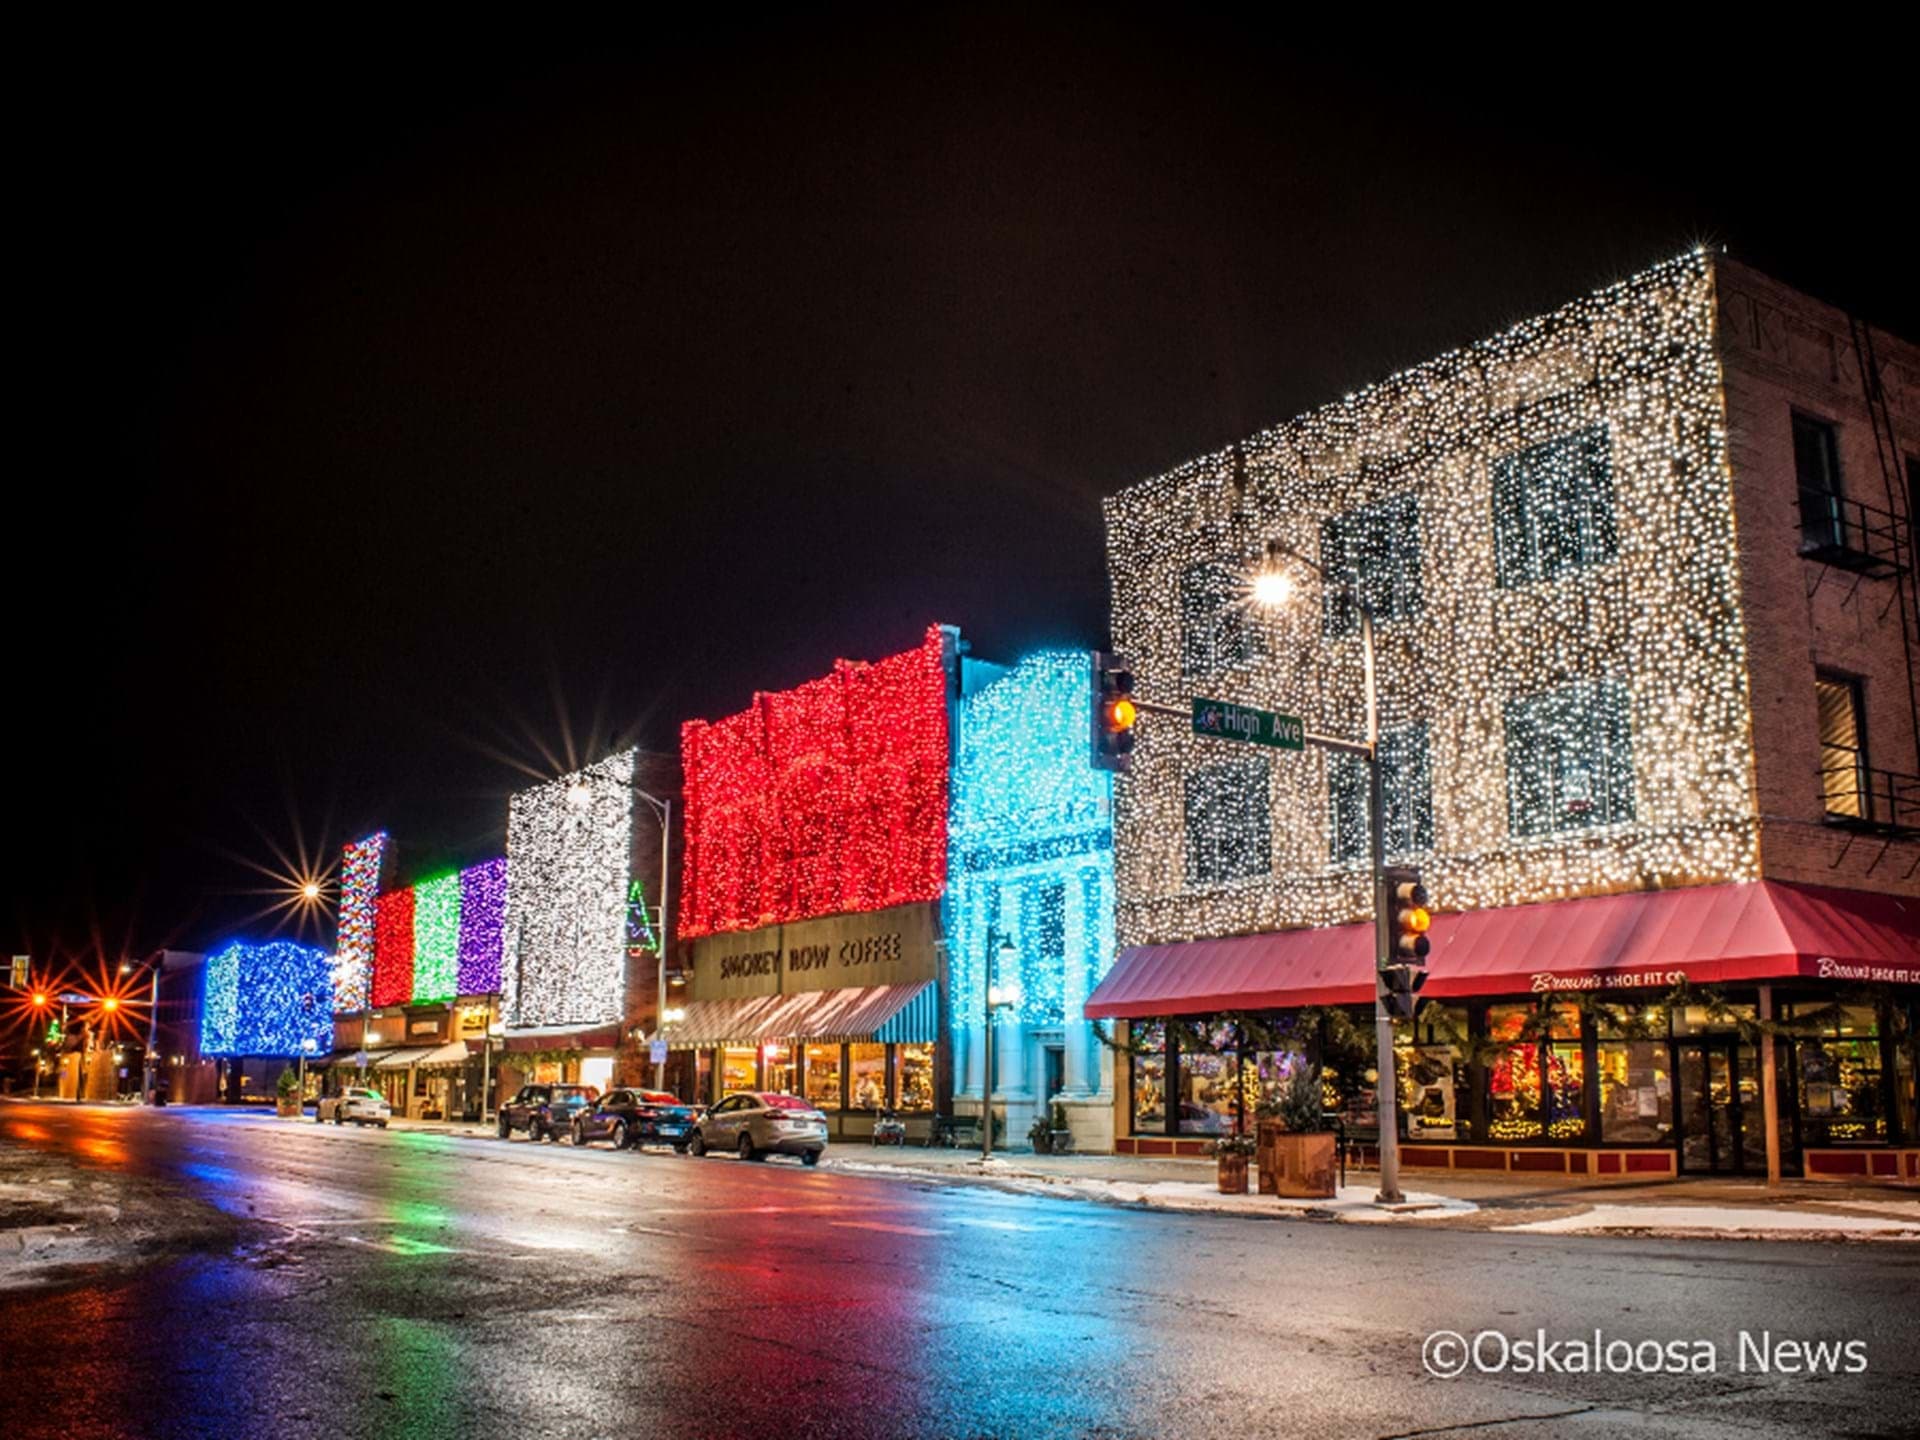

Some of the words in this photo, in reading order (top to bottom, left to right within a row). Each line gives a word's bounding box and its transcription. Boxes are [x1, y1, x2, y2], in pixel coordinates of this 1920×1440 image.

[1224, 706, 1260, 741] High
[1272, 715, 1300, 742] Ave
[720, 950, 782, 980] SMOKEY
[789, 943, 831, 972] ROW
[839, 933, 902, 967] COFFEE
[1817, 957, 1870, 979] Brown's
[1530, 972, 1601, 993] Brown's
[1605, 973, 1641, 988] SHOE
[1644, 971, 1662, 985] FIT
